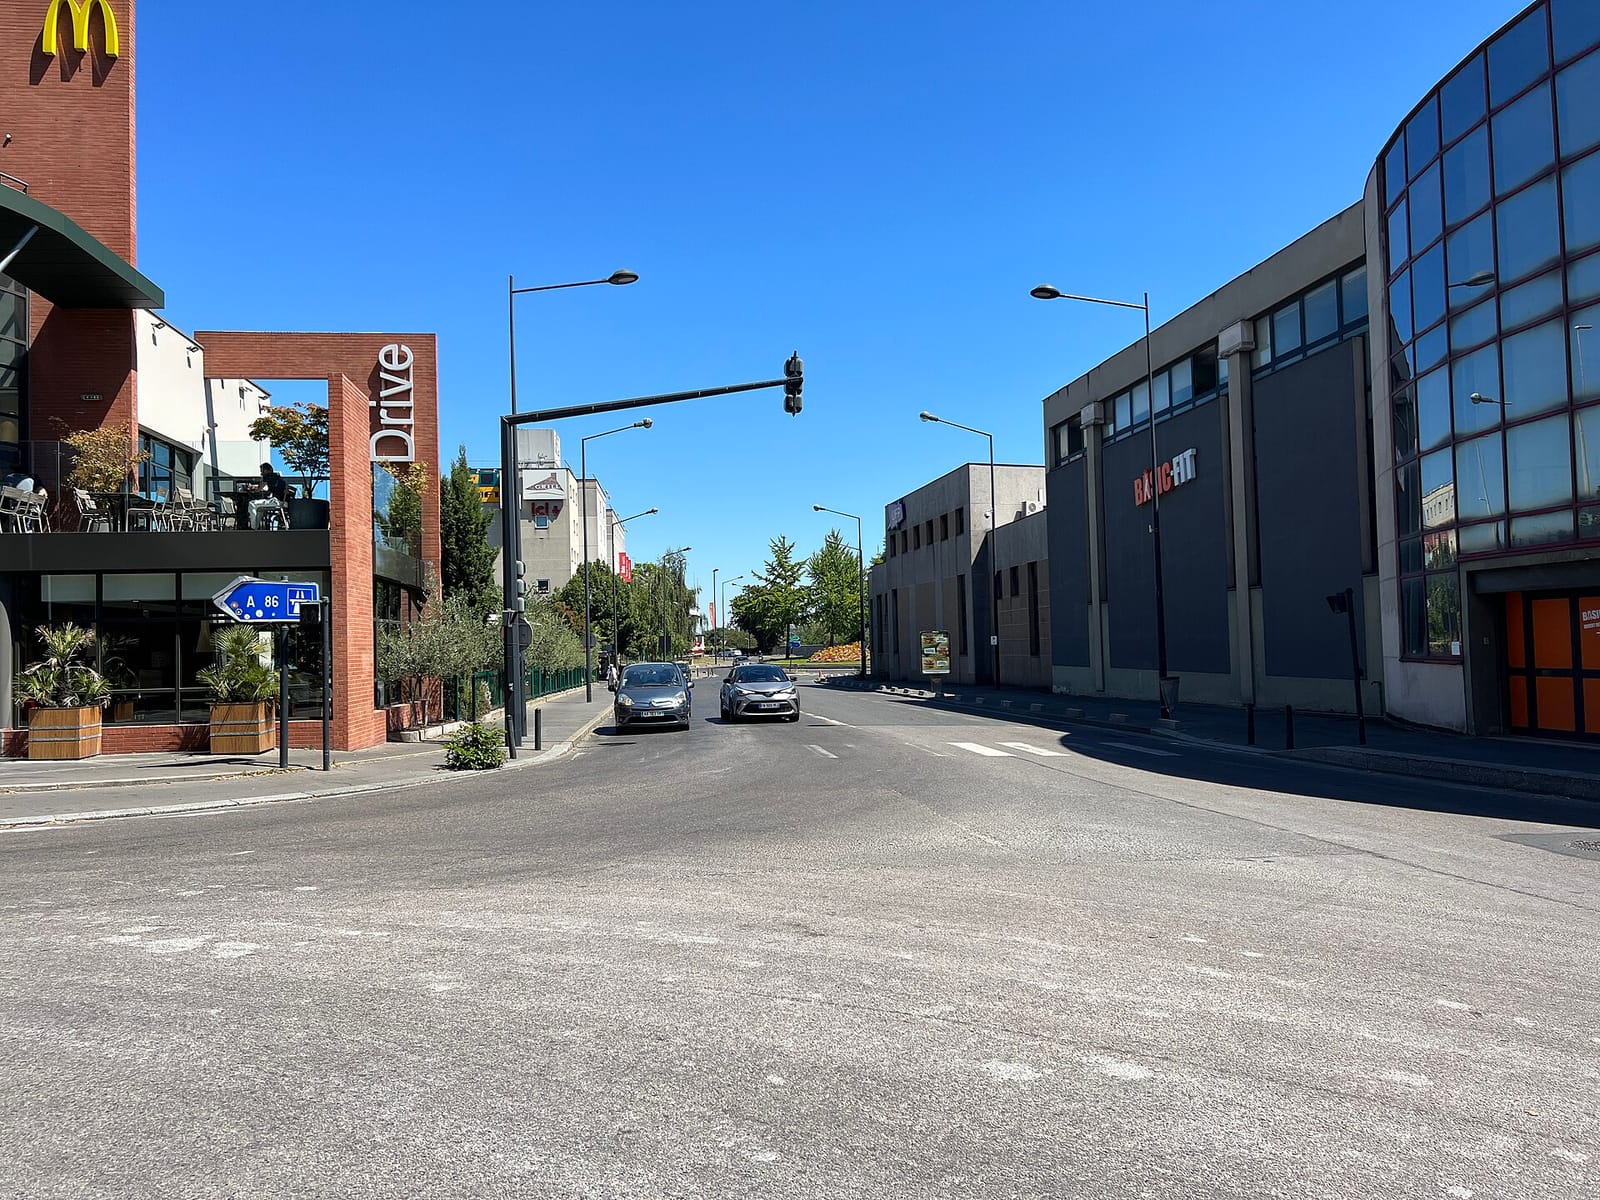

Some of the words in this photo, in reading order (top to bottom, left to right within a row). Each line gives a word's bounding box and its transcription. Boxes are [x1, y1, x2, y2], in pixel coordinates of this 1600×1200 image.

[368, 343, 415, 462] Drive
[246, 595, 256, 608] A
[264, 595, 280, 608] 86
